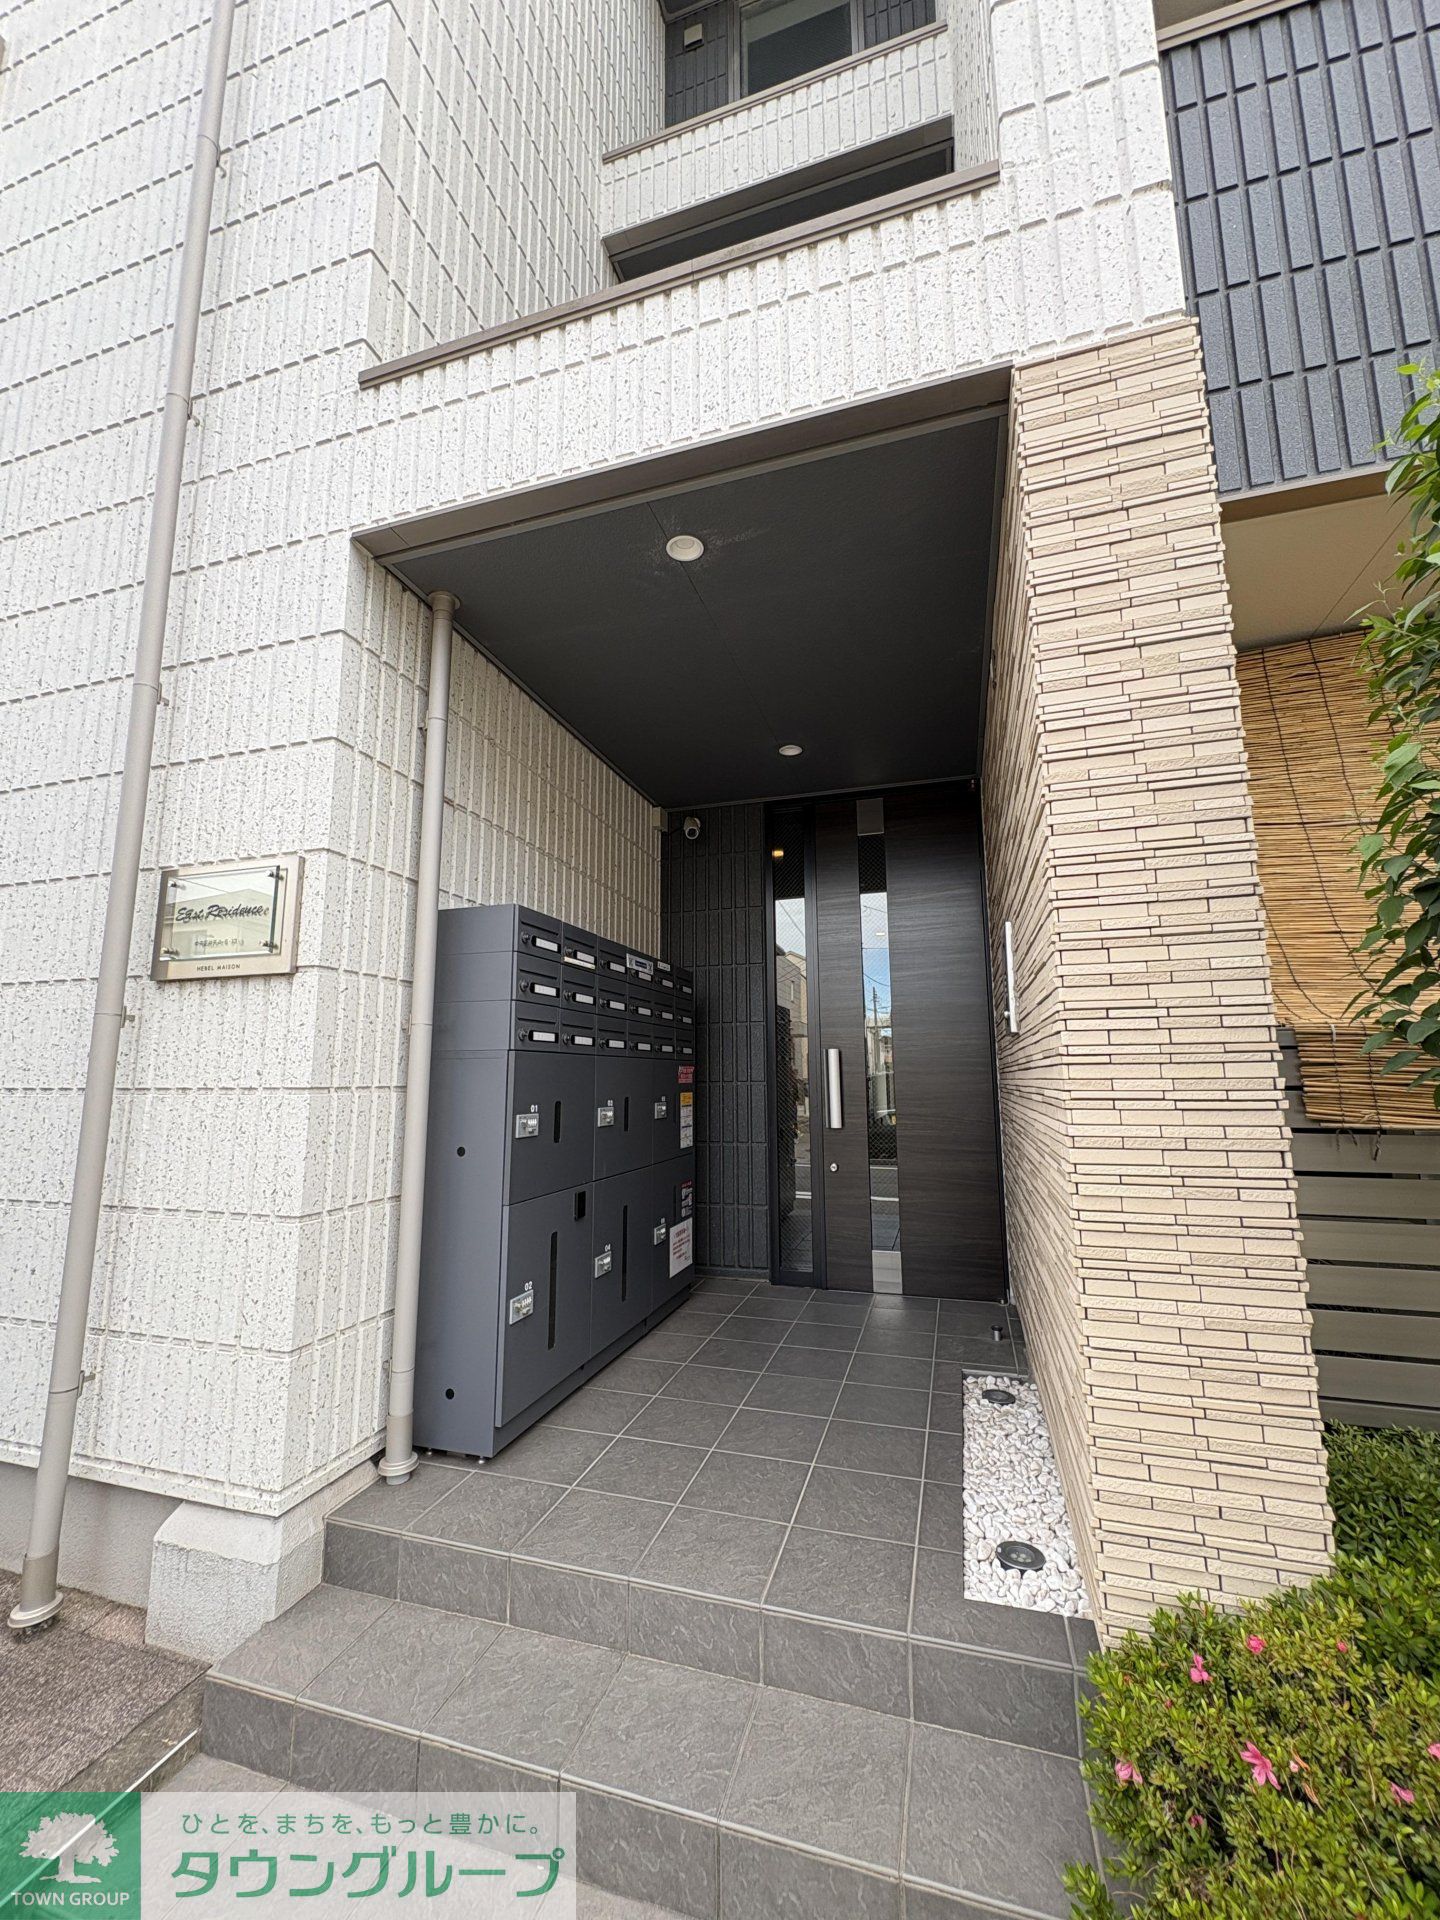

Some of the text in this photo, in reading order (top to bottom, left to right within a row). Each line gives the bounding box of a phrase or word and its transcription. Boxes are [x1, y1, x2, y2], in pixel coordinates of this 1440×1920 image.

[176, 906, 204, 924] East
[530, 1104, 538, 1112] 01
[524, 1280, 533, 1291] 02
